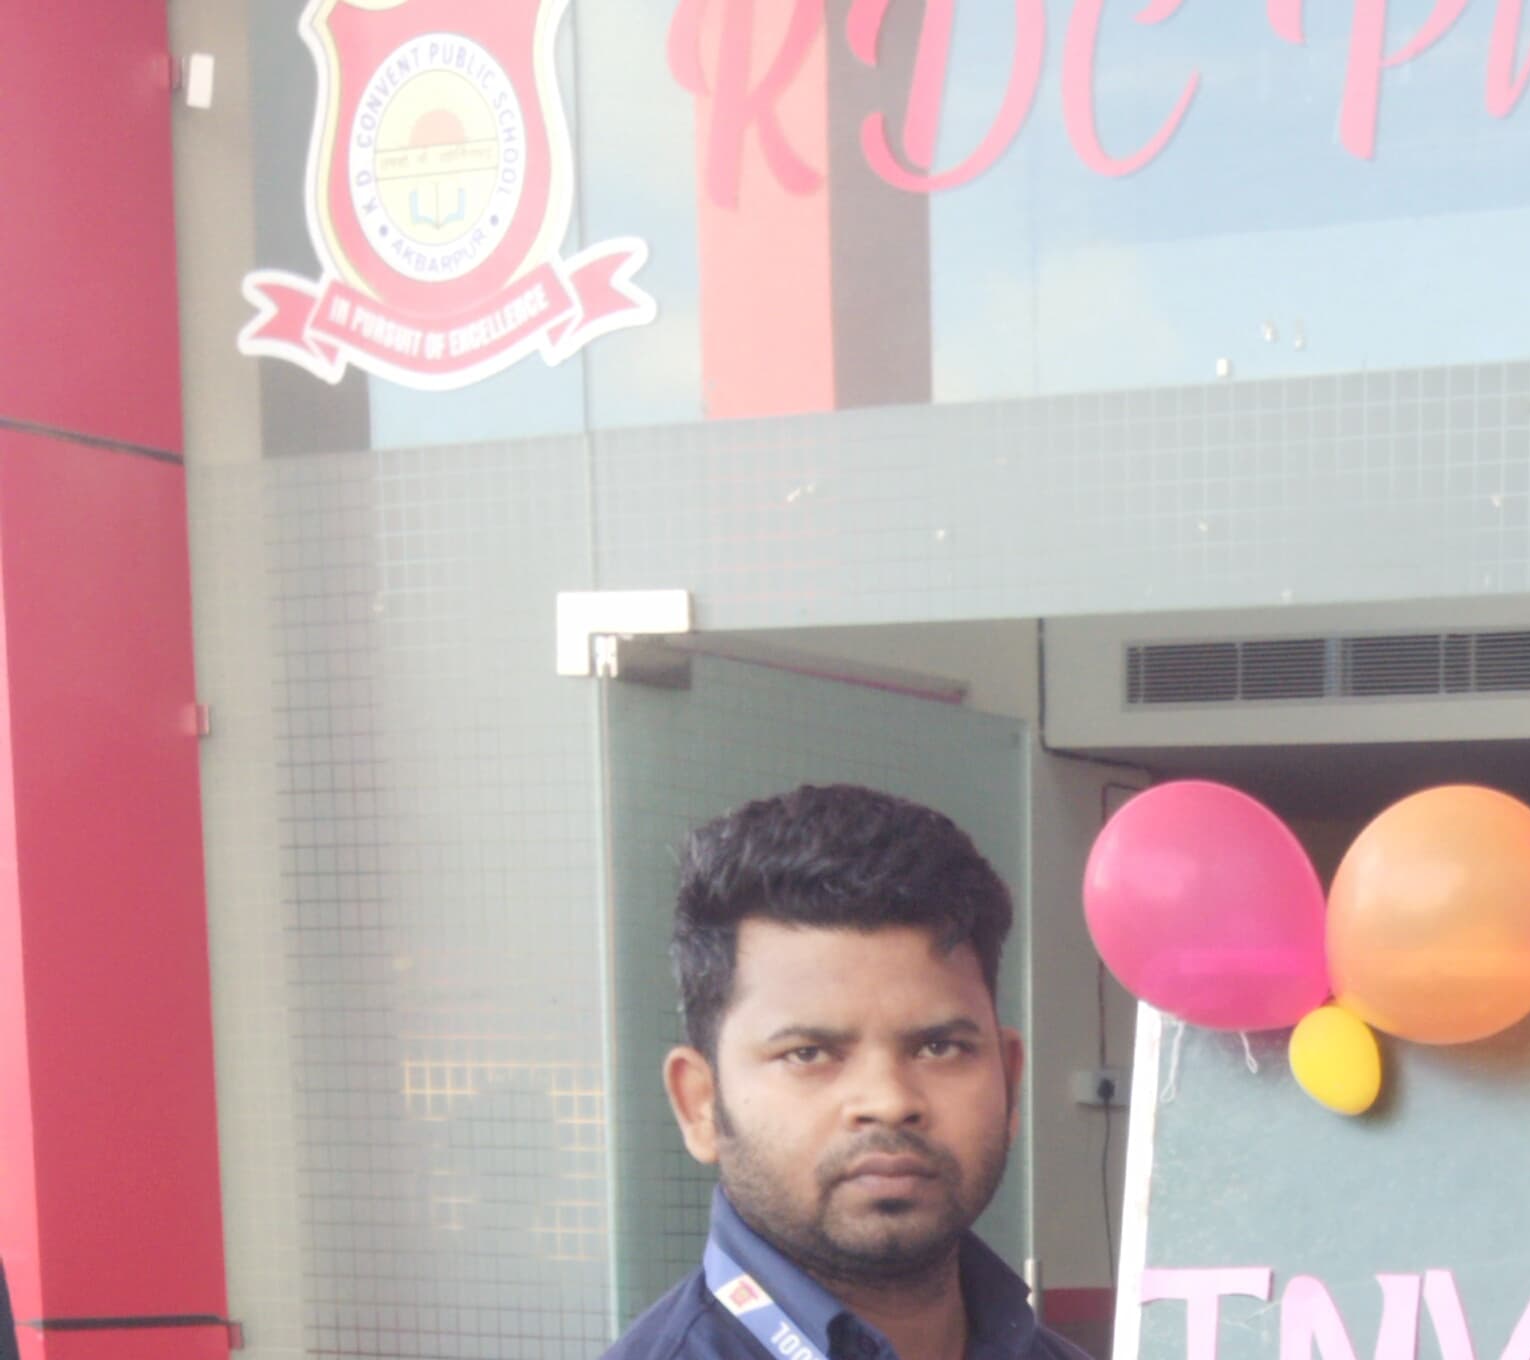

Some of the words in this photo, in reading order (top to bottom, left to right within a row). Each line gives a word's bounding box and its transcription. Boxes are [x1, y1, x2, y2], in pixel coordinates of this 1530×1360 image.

[428, 40, 496, 91] PUBLIC
[356, 45, 421, 150] CONVENT
[492, 90, 520, 196] SCHOOL
[355, 169, 373, 188] D
[391, 227, 488, 274] AKBARPUR
